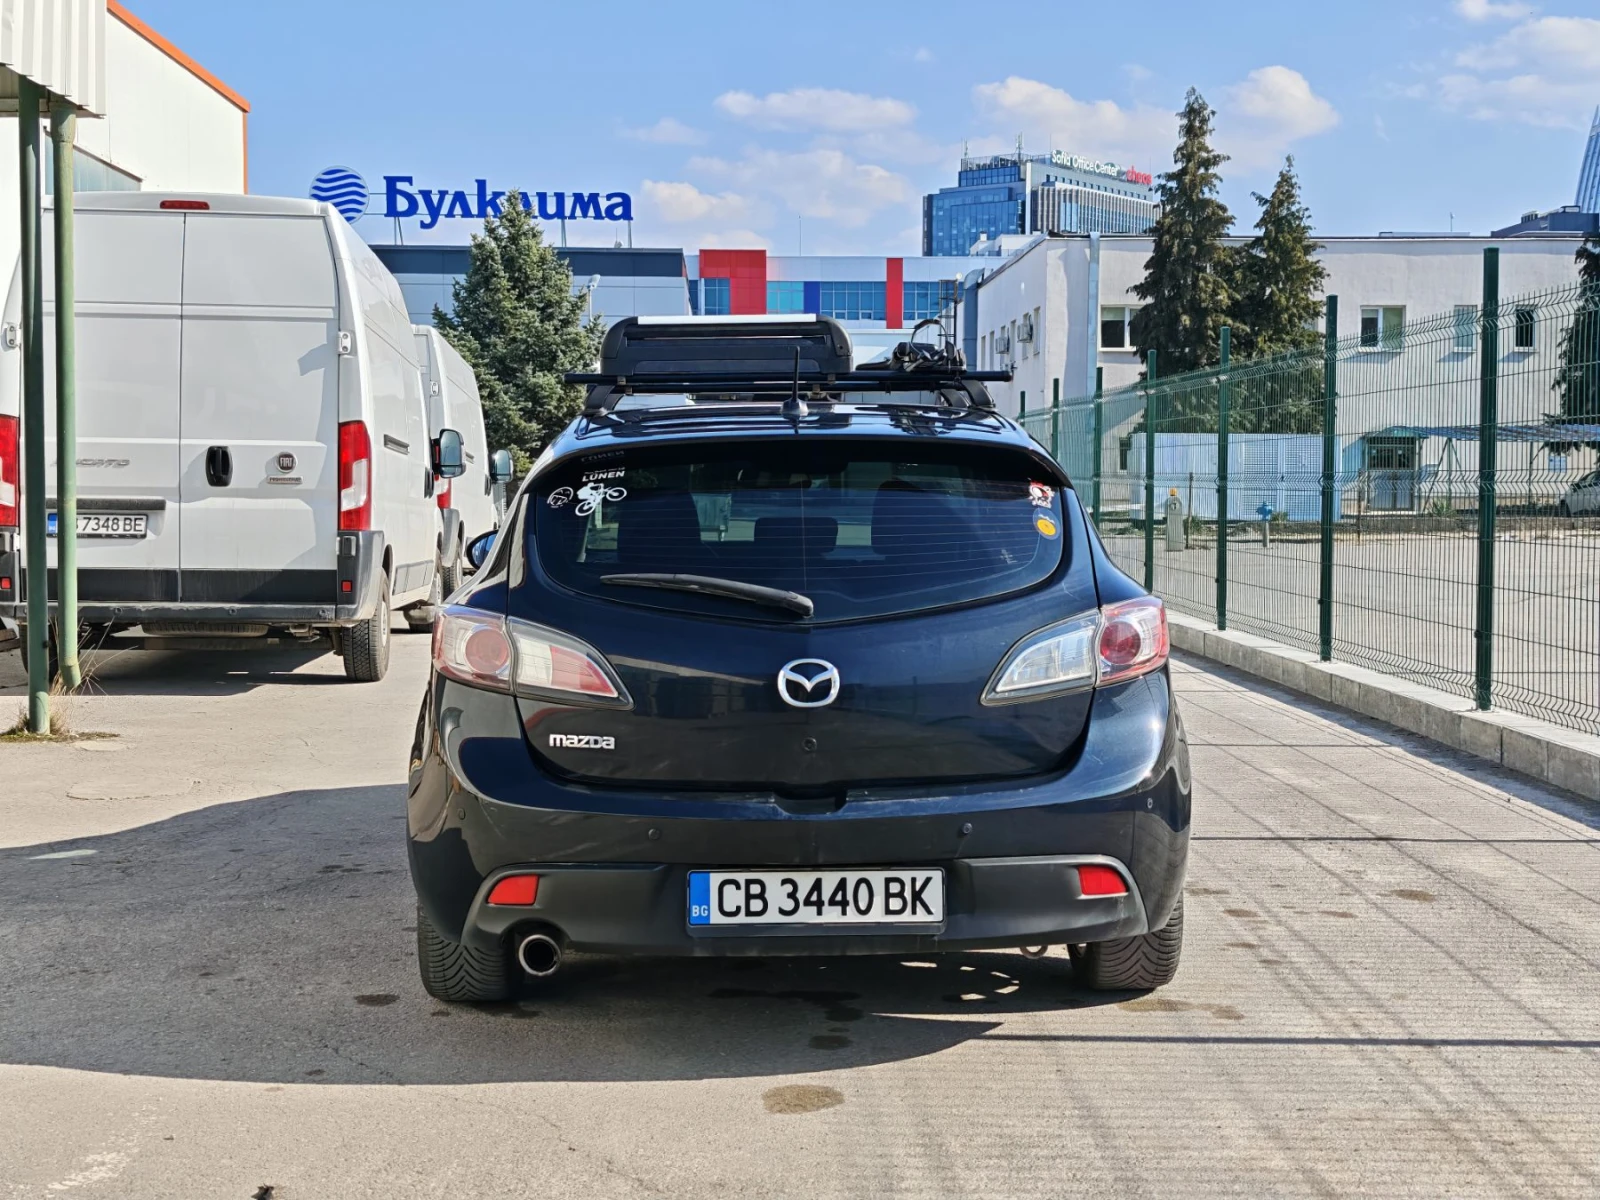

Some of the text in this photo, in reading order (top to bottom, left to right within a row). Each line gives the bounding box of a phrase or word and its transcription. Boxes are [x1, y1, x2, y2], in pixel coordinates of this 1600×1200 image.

[1052, 150, 1119, 177] Sofia Office Center
[280, 457, 293, 468] FIAT
[82, 517, 120, 532] 7348
[123, 517, 144, 532] BE
[717, 876, 934, 918] CB 3440 BK
[692, 905, 709, 917] BG
